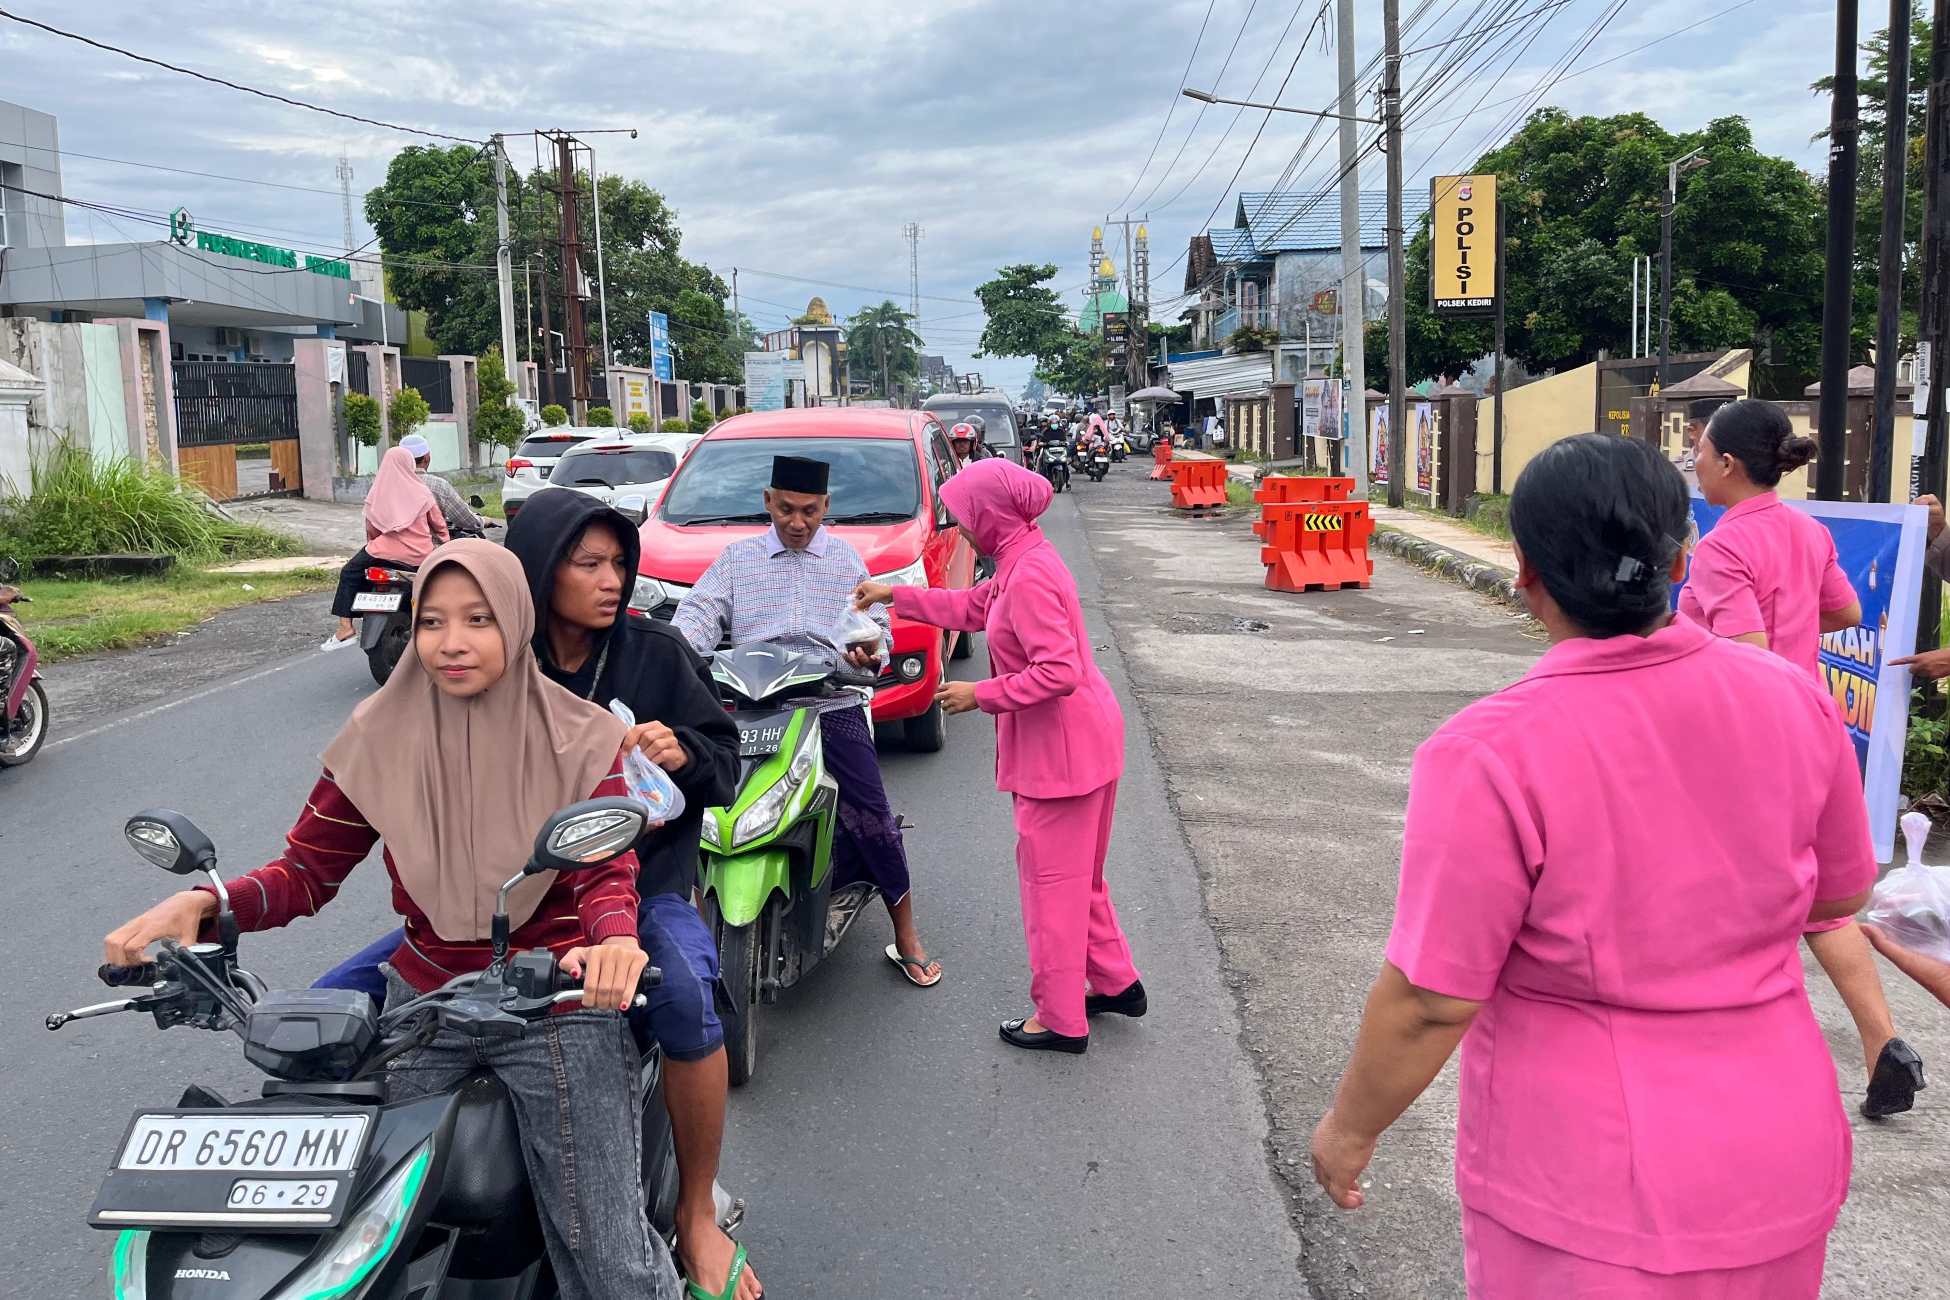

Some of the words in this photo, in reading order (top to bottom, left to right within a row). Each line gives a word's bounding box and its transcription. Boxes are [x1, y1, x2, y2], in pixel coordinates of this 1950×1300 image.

[1456, 208, 1474, 294] POLISI
[1437, 300, 1466, 308] POLSEK
[1467, 299, 1492, 307] KEDIRI
[761, 727, 781, 741] HH
[136, 1129, 188, 1165] DR
[195, 1129, 288, 1166] 6560
[293, 1128, 350, 1166] MN
[174, 1269, 231, 1281] HONDA
